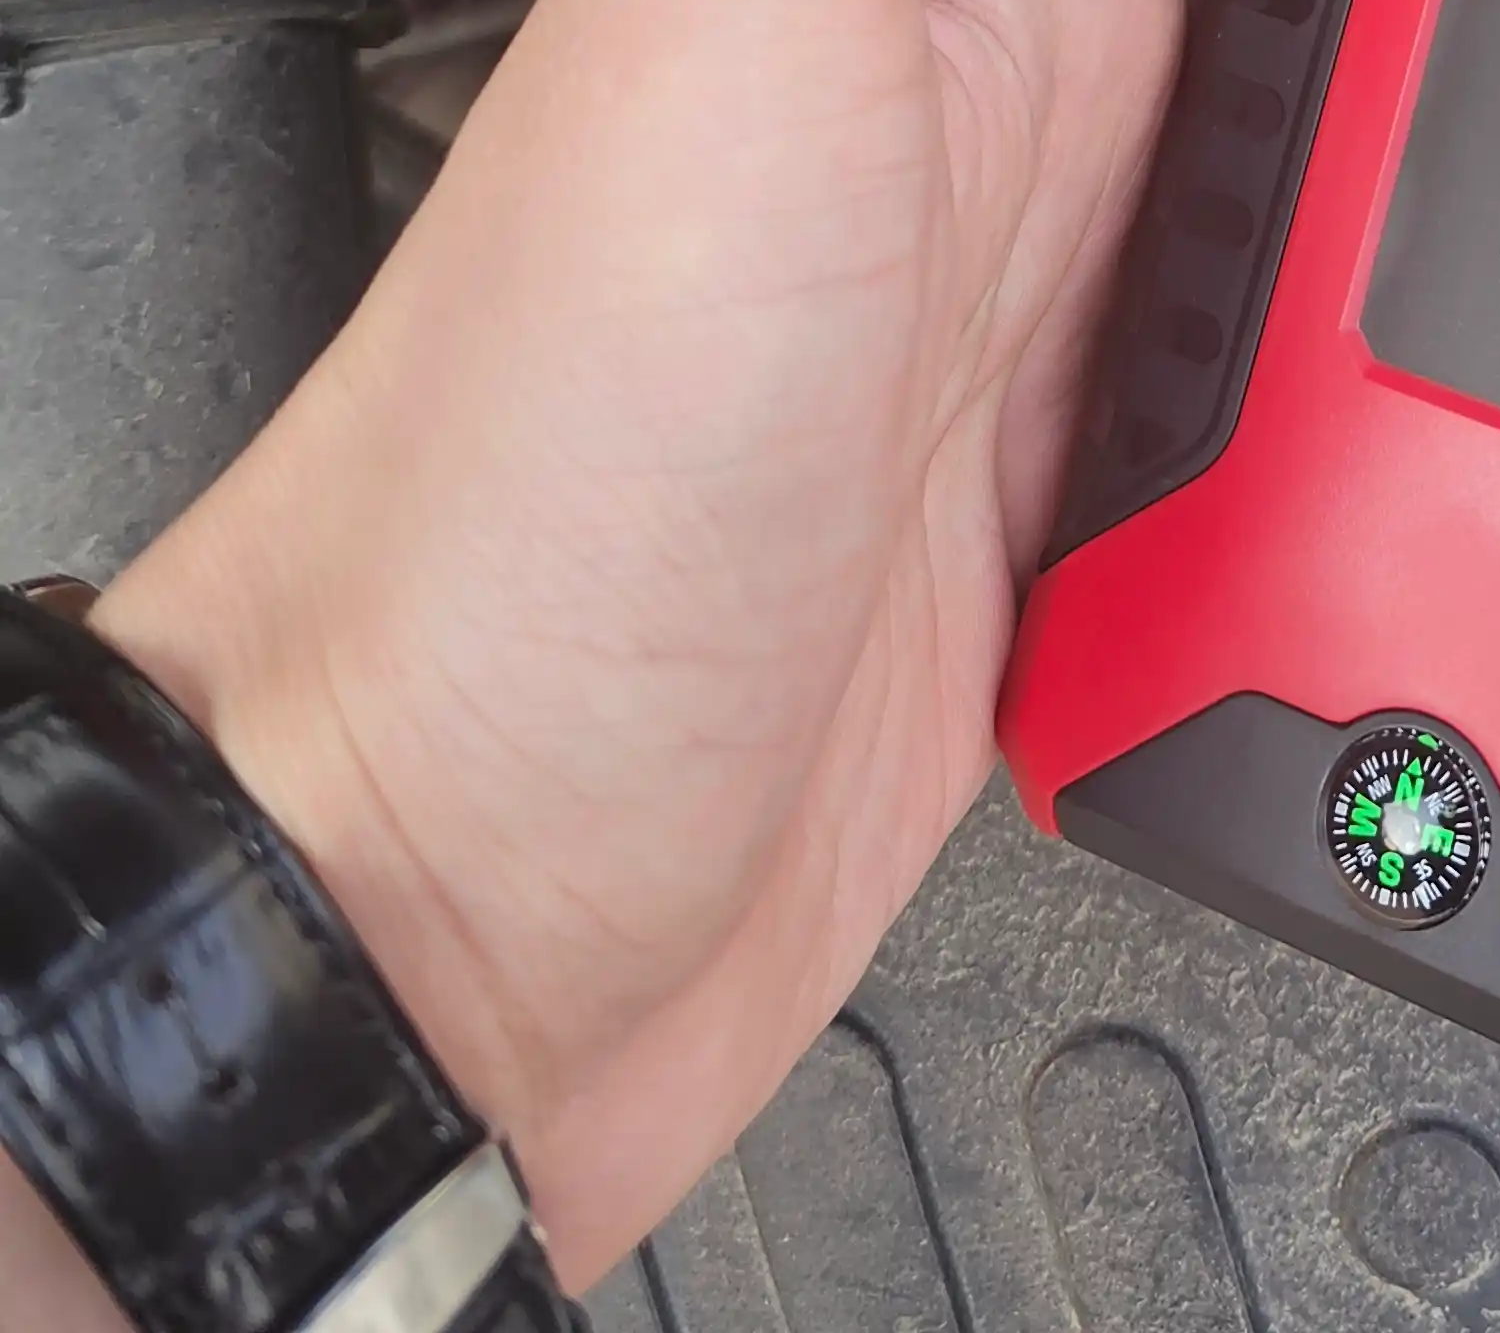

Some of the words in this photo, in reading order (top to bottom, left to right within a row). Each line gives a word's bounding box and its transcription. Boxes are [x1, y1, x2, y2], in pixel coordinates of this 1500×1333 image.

[1394, 772, 1425, 813] N
[1348, 792, 1382, 837] W
[1420, 822, 1455, 858] E
[1378, 851, 1405, 887] S
